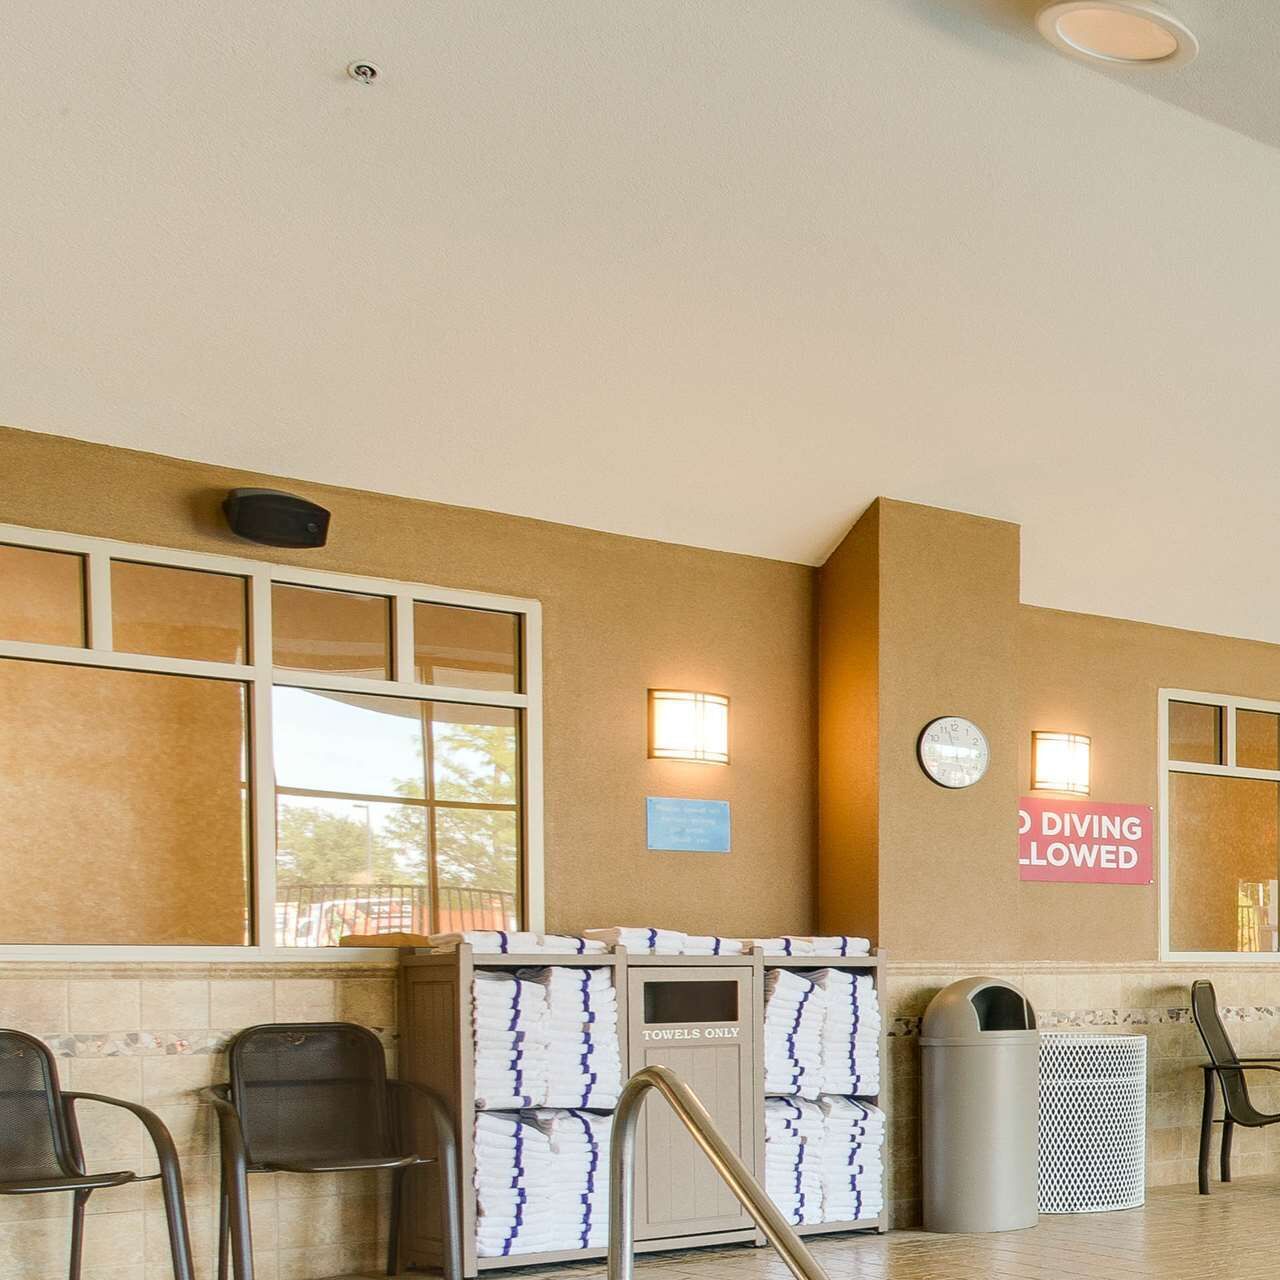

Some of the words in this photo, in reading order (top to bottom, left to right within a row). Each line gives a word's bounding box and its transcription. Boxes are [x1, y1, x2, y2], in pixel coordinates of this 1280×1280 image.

[951, 723, 959, 732] 12
[1042, 811, 1143, 841] DIVING
[642, 1028, 701, 1041] TOWELS
[704, 1027, 740, 1038] ONLY
